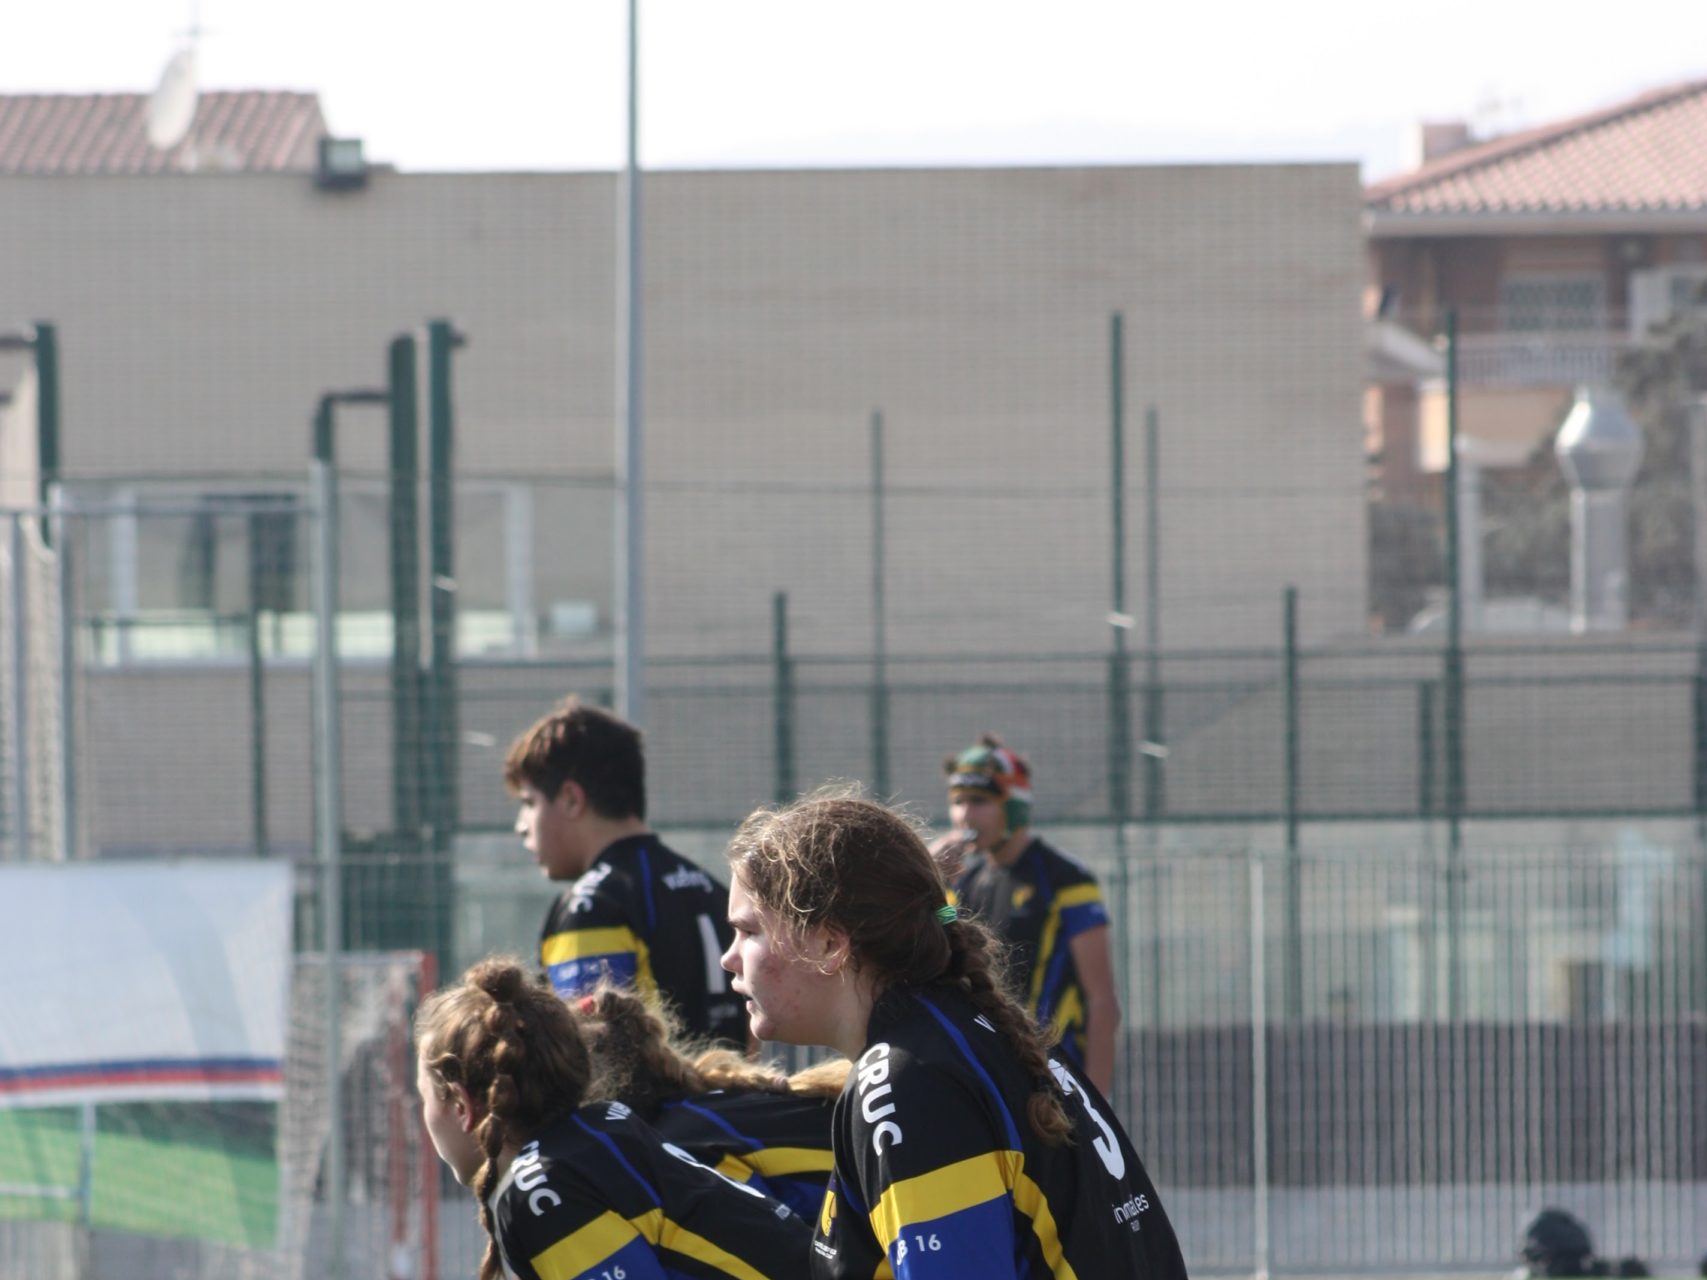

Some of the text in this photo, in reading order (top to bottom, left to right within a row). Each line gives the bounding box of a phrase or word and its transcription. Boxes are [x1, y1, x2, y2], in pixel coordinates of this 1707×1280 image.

[858, 1042, 903, 1156] CRUC
[1047, 1058, 1126, 1181] 3
[915, 1234, 942, 1252] 16
